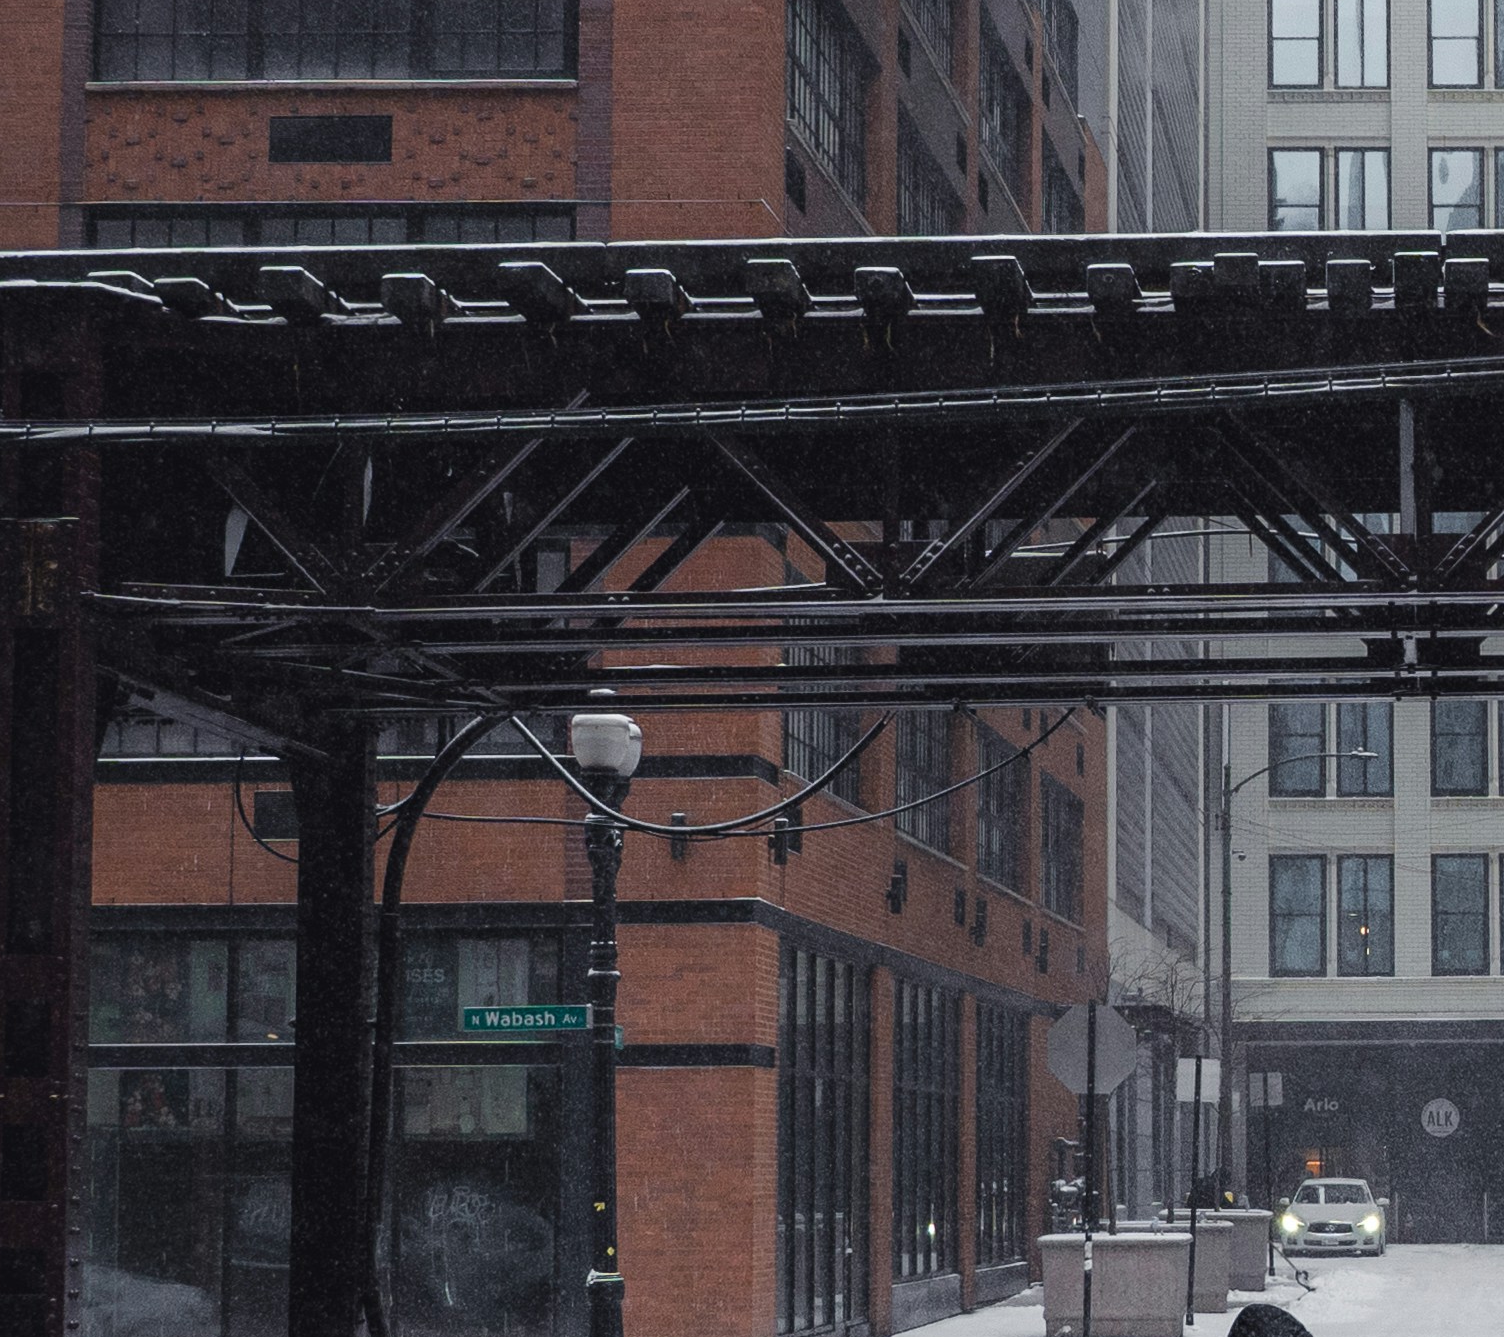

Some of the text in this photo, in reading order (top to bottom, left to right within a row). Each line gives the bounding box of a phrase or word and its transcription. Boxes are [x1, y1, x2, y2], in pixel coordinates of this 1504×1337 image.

[472, 1011, 577, 1026] N Wabash Av
[1303, 1097, 1339, 1112] Arlo
[1427, 1110, 1453, 1127] ALK
